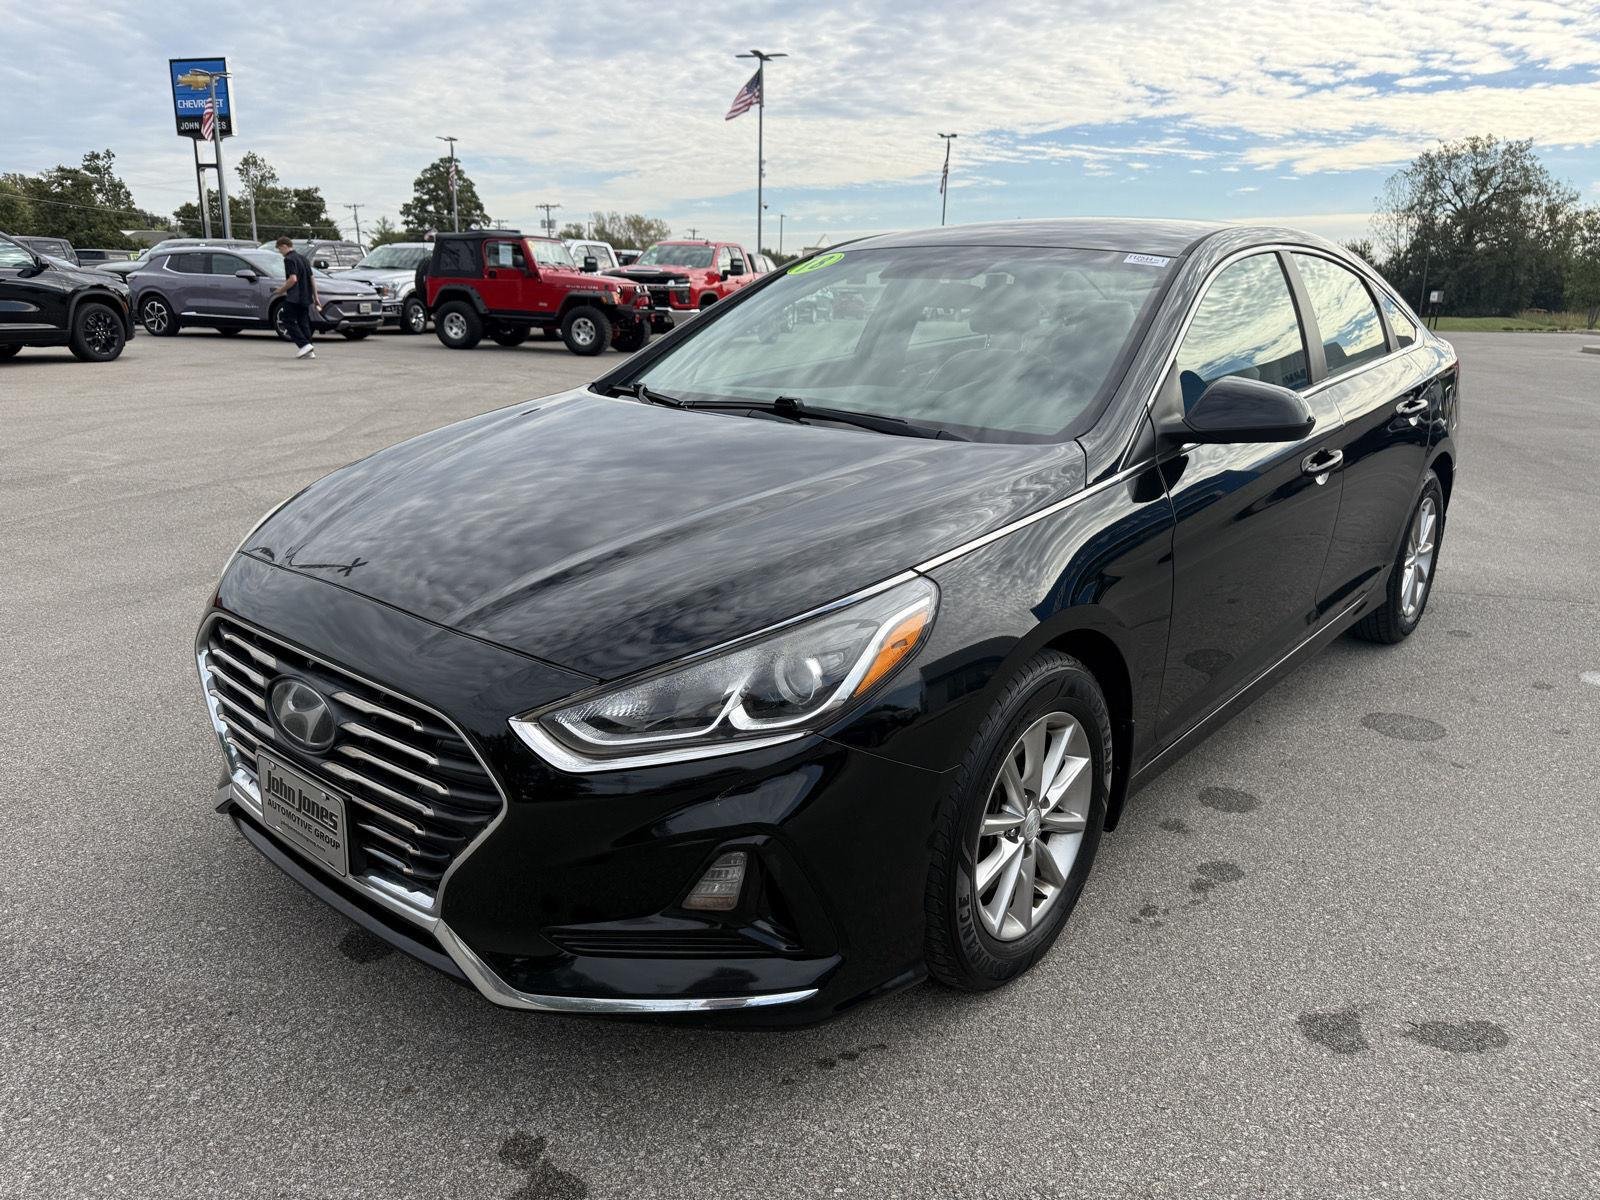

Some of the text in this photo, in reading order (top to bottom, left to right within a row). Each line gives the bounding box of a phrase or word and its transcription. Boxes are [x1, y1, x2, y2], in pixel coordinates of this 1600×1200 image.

[177, 99, 224, 109] CHEVRET
[180, 121, 200, 130] JOHN
[265, 769, 339, 833] John Jones
[267, 798, 313, 834] AUTOMOTIVE
[314, 827, 341, 850] GROUP
